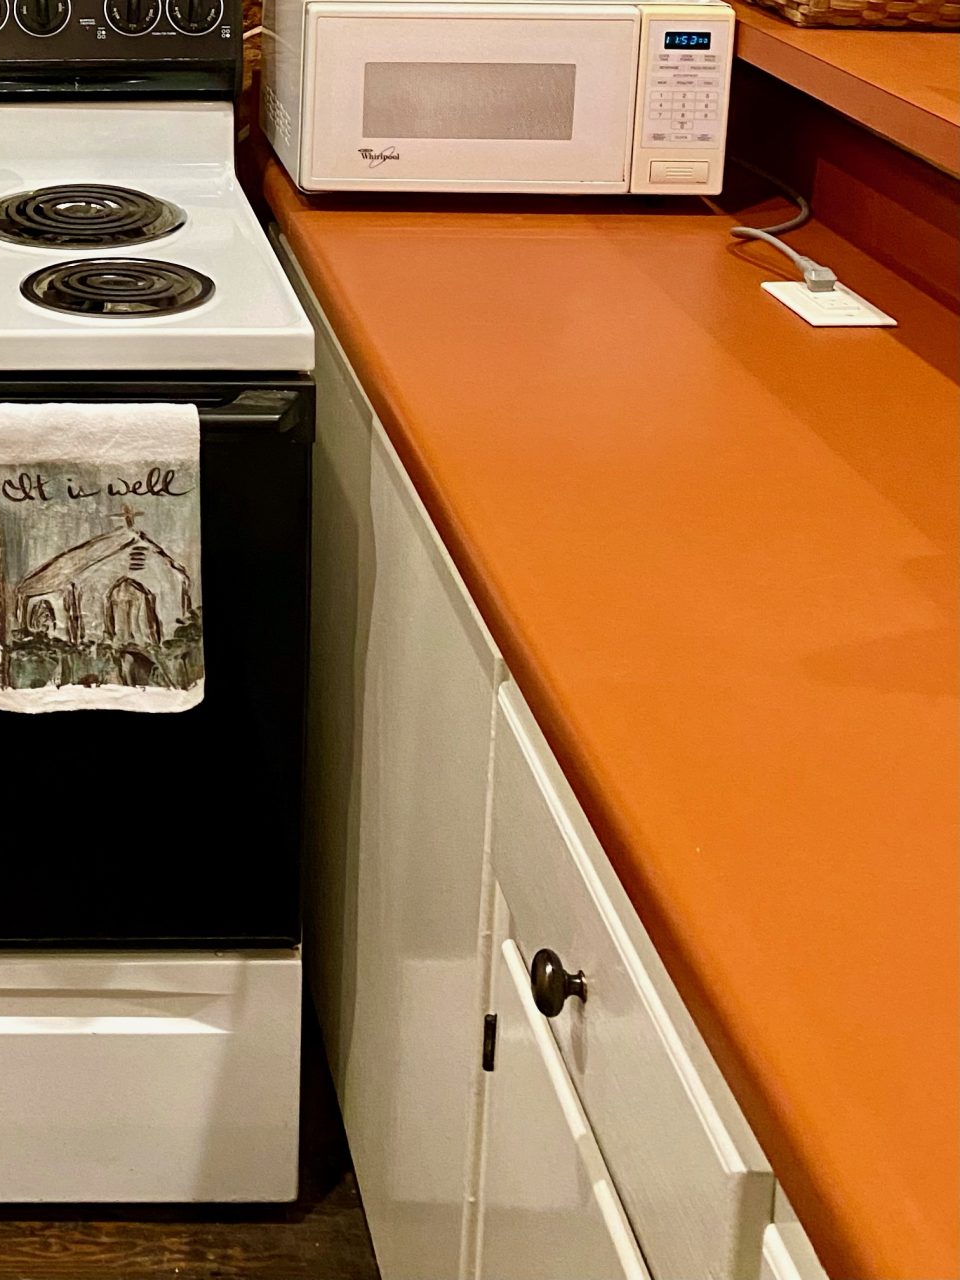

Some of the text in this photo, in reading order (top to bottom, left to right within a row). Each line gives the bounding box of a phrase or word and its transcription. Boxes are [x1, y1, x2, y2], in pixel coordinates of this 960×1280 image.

[666, 35, 697, 45] 11:53
[361, 152, 400, 162] Whirlpool
[67, 478, 102, 500] is
[107, 467, 193, 497] well
